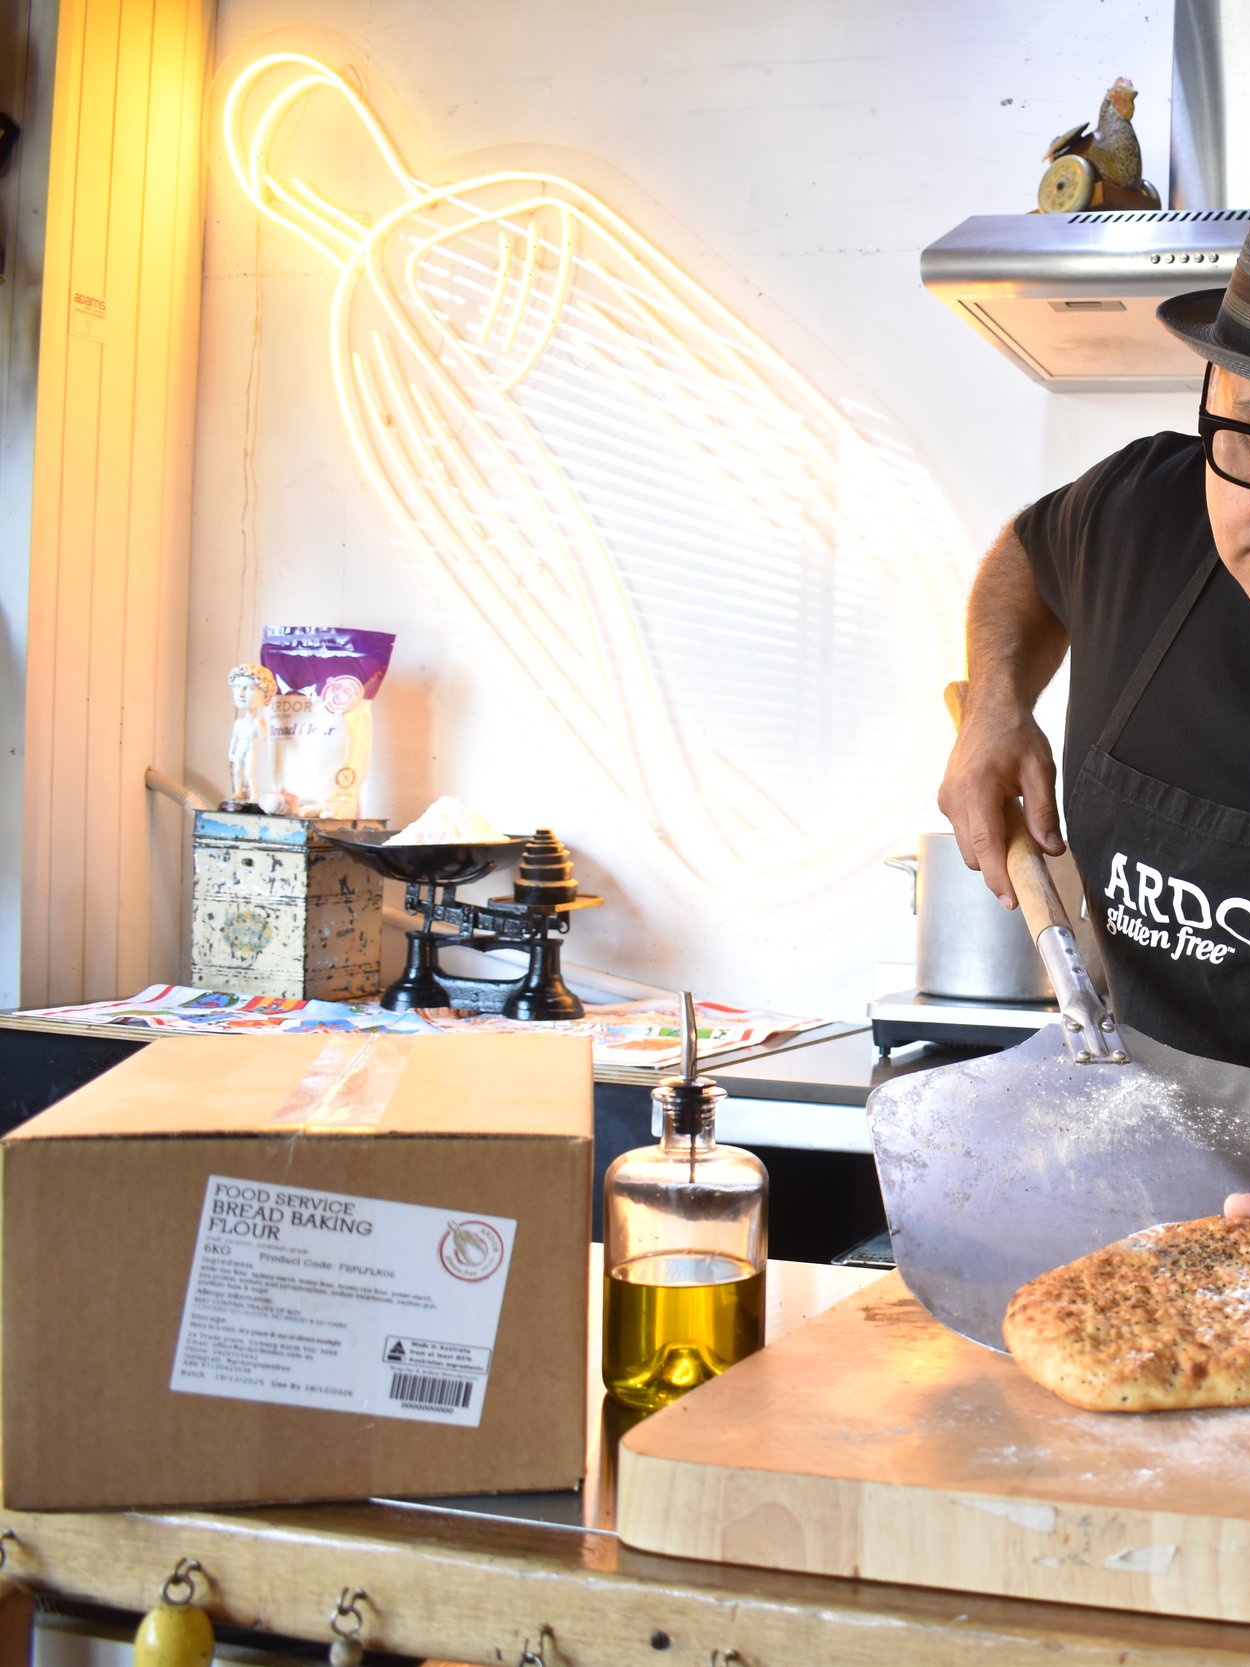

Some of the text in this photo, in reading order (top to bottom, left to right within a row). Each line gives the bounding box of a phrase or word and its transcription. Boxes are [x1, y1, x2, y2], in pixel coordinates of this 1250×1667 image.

[1106, 904, 1171, 950] gluten
[215, 1184, 355, 1215] FOOD SERVICE
[208, 1217, 281, 1240] FLOUR
[212, 1200, 373, 1235] BREAD BAKING
[259, 1252, 301, 1265] Product
